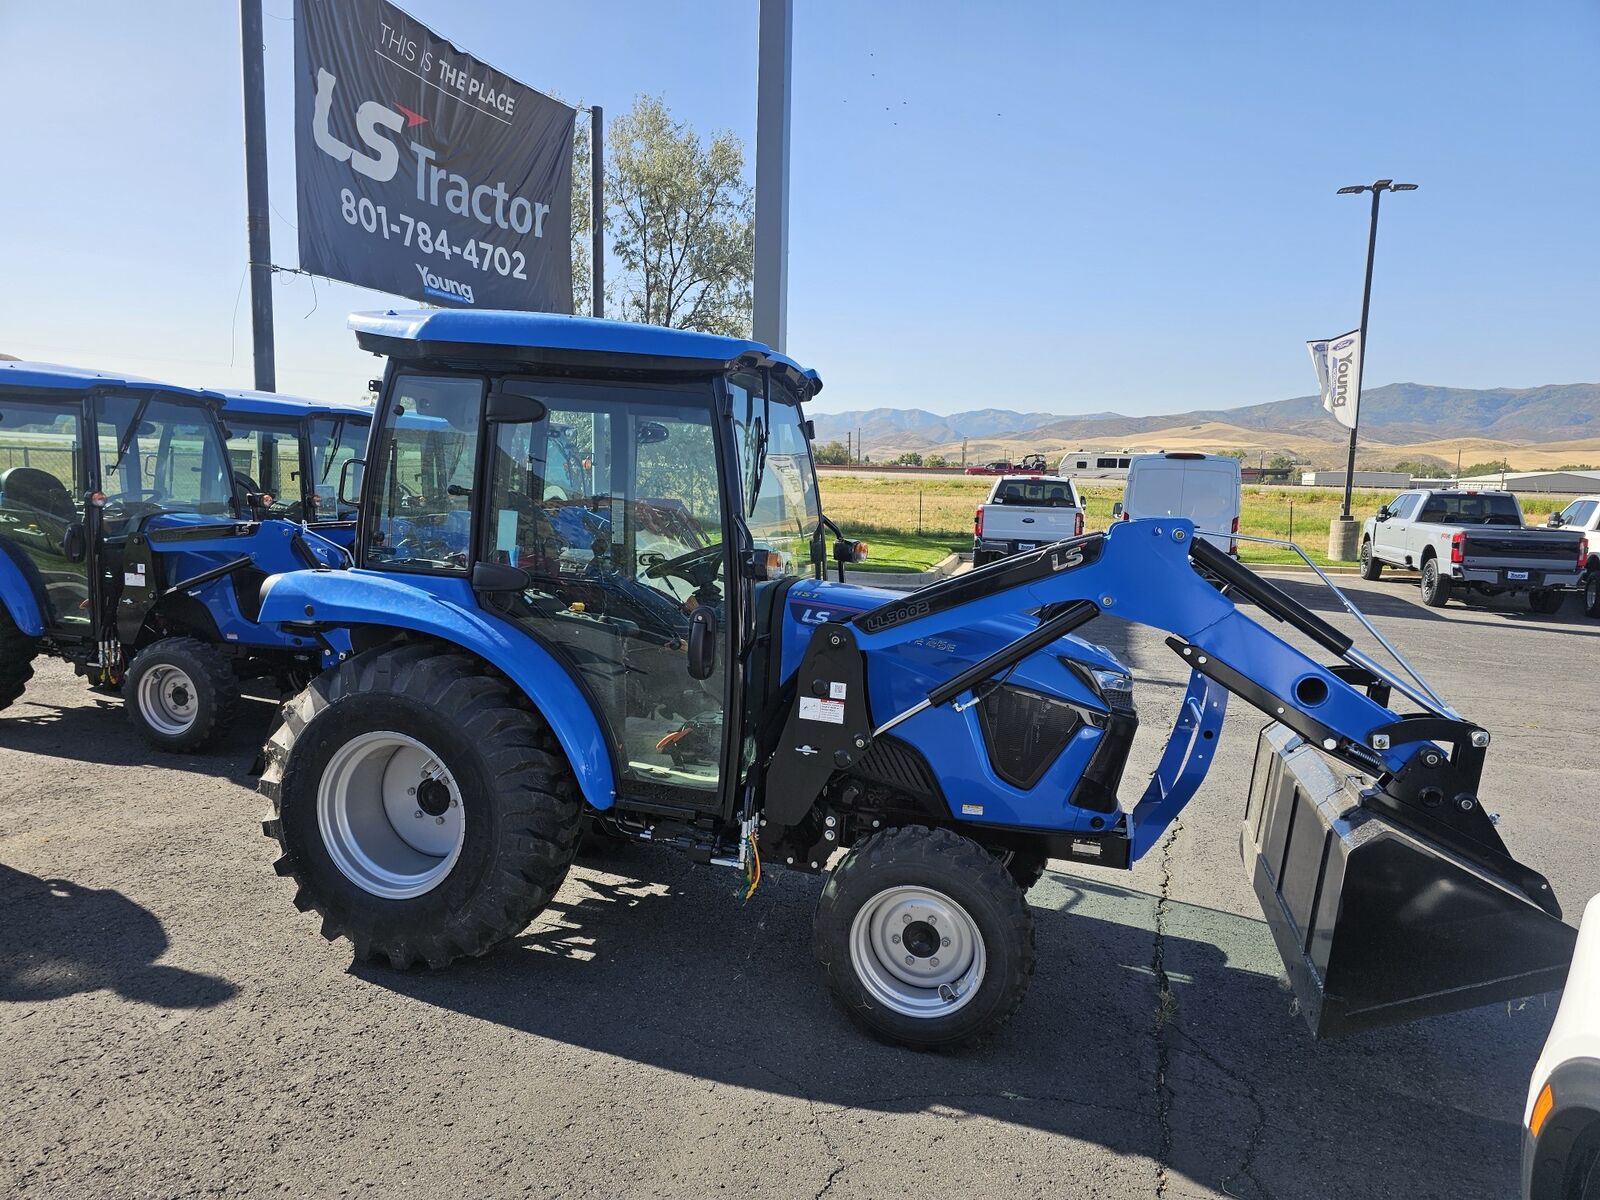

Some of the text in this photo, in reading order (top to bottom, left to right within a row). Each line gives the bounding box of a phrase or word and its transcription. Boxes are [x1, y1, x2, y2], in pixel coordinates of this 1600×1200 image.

[381, 22, 515, 115] THIS IS THE PLACE
[313, 67, 405, 182] LS
[410, 140, 550, 238] Tractor
[340, 188, 528, 281] 801-784-4702
[415, 263, 475, 304] Young
[1333, 351, 1354, 408] Young
[1051, 546, 1084, 571] LS
[801, 608, 831, 624] LS
[867, 600, 930, 632] LL3002
